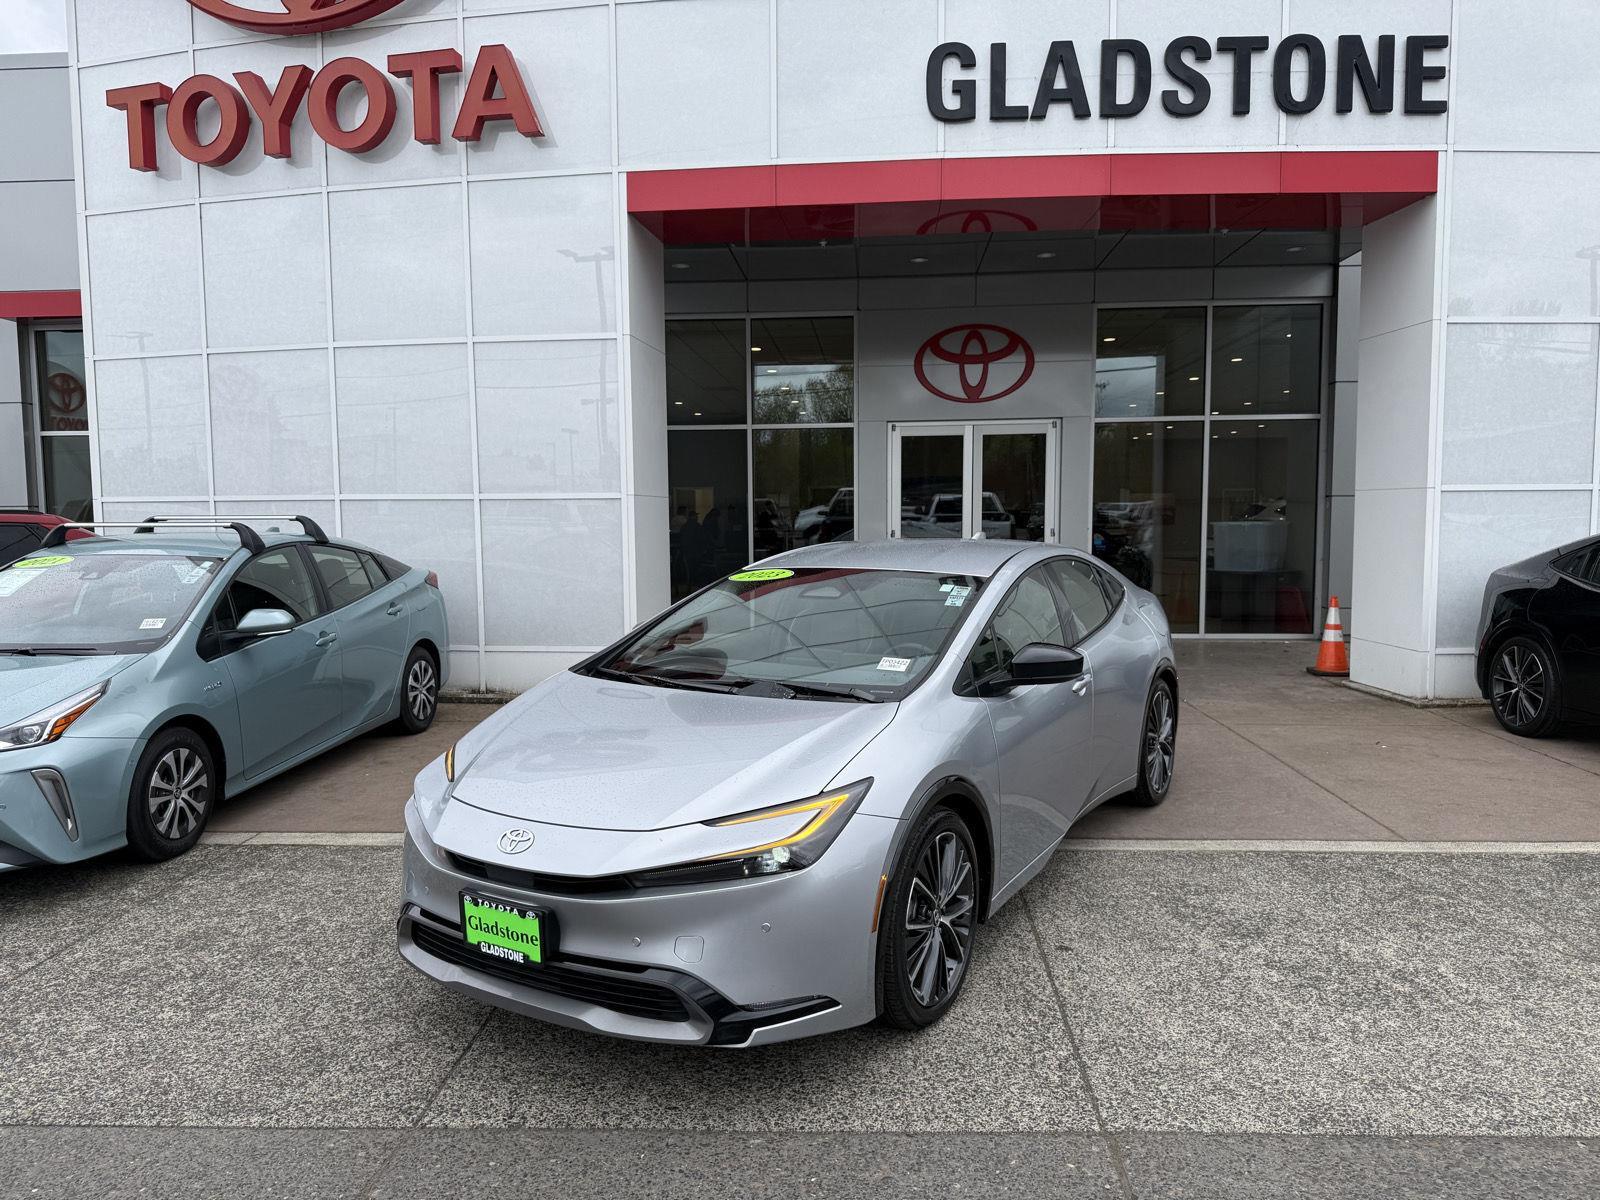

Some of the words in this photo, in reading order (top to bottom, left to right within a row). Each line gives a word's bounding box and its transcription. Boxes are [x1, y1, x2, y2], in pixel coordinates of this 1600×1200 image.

[926, 33, 1449, 122] GLADSTONE
[106, 44, 545, 172] TOYOTA
[477, 898, 519, 916] TOYOTA
[467, 915, 539, 946] Gladstone
[480, 941, 525, 963] GLADSTONE
